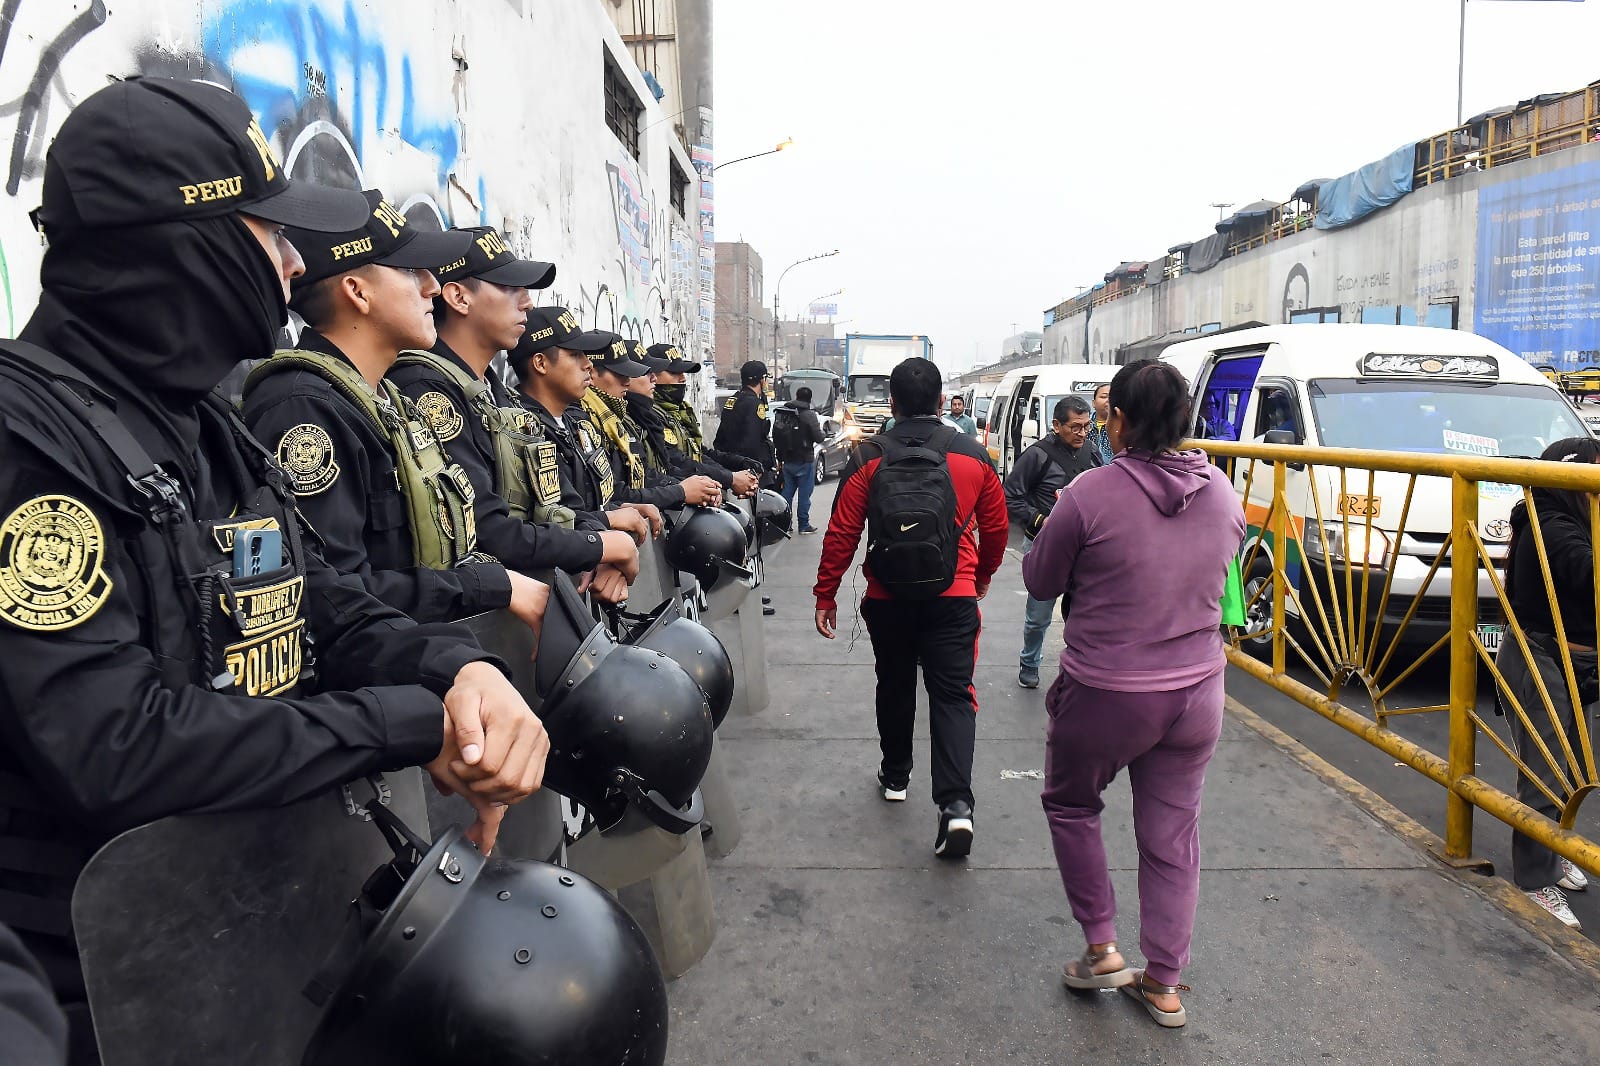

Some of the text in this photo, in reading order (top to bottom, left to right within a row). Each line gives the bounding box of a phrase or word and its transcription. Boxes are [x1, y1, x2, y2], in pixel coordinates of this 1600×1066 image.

[179, 175, 242, 205] PERU
[331, 236, 373, 260] PERU
[1518, 231, 1590, 250] Esta pared filtra
[1493, 255, 1502, 265] la
[1503, 254, 1532, 265] misma
[1533, 246, 1573, 262] cantidad
[1574, 246, 1587, 257] de
[1511, 268, 1528, 279] que
[1528, 265, 1546, 276] 250
[530, 326, 554, 342] PERU
[283, 427, 304, 448] POLICIA
[1446, 440, 1498, 456] VITARTE
[6, 500, 53, 536] POLICIA
[56, 500, 99, 553] NACIONAL
[12, 593, 99, 625] POLICIAL LIMA
[226, 629, 302, 697] POLICIA
